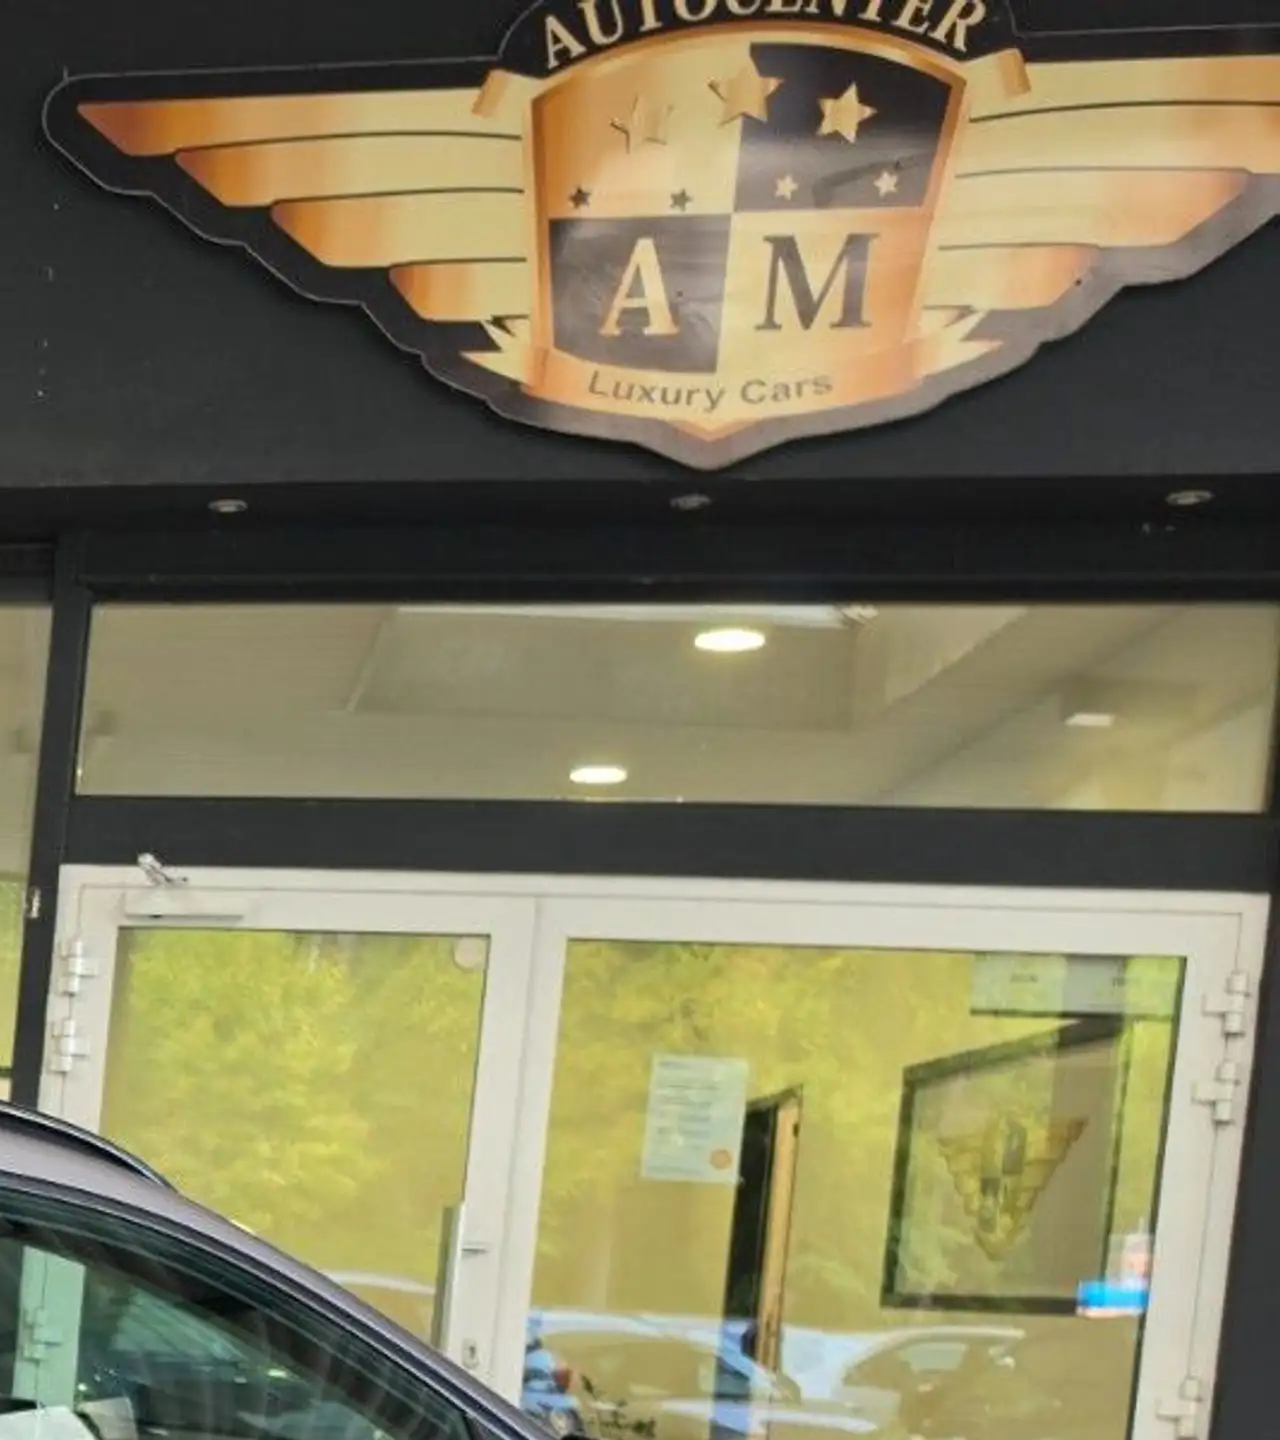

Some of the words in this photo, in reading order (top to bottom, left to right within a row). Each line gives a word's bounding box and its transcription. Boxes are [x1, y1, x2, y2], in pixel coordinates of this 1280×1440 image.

[598, 236, 681, 338] A
[752, 232, 880, 332] M
[588, 369, 727, 413] Luxury
[739, 372, 834, 406] Cars
